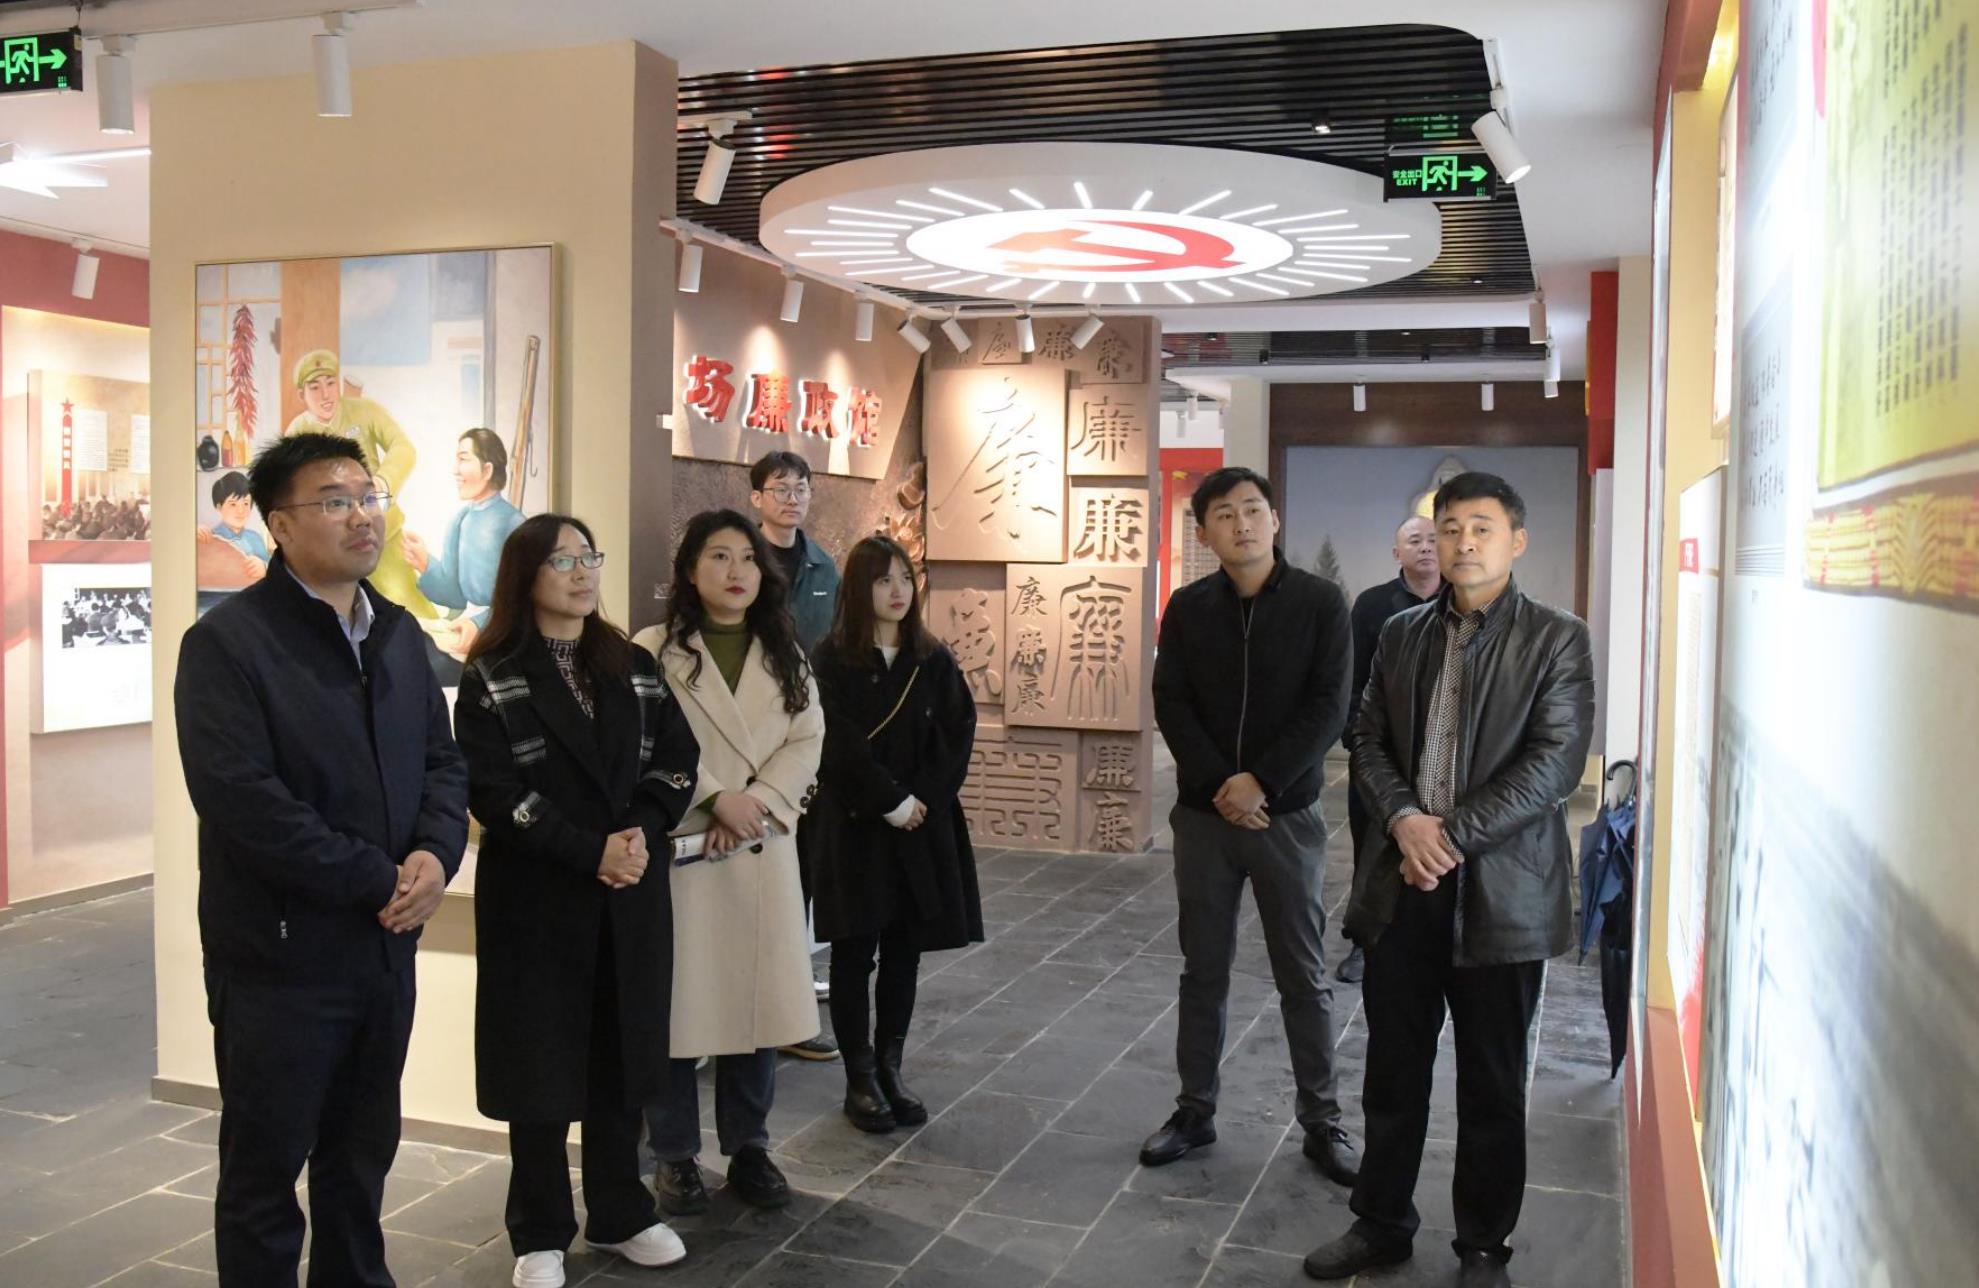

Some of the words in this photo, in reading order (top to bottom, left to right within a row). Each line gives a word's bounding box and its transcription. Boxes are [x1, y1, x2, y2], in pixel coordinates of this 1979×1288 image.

[1392, 169, 1422, 178] 安全出口
[1396, 178, 1418, 186] EXIT
[1070, 396, 1142, 463] 廉
